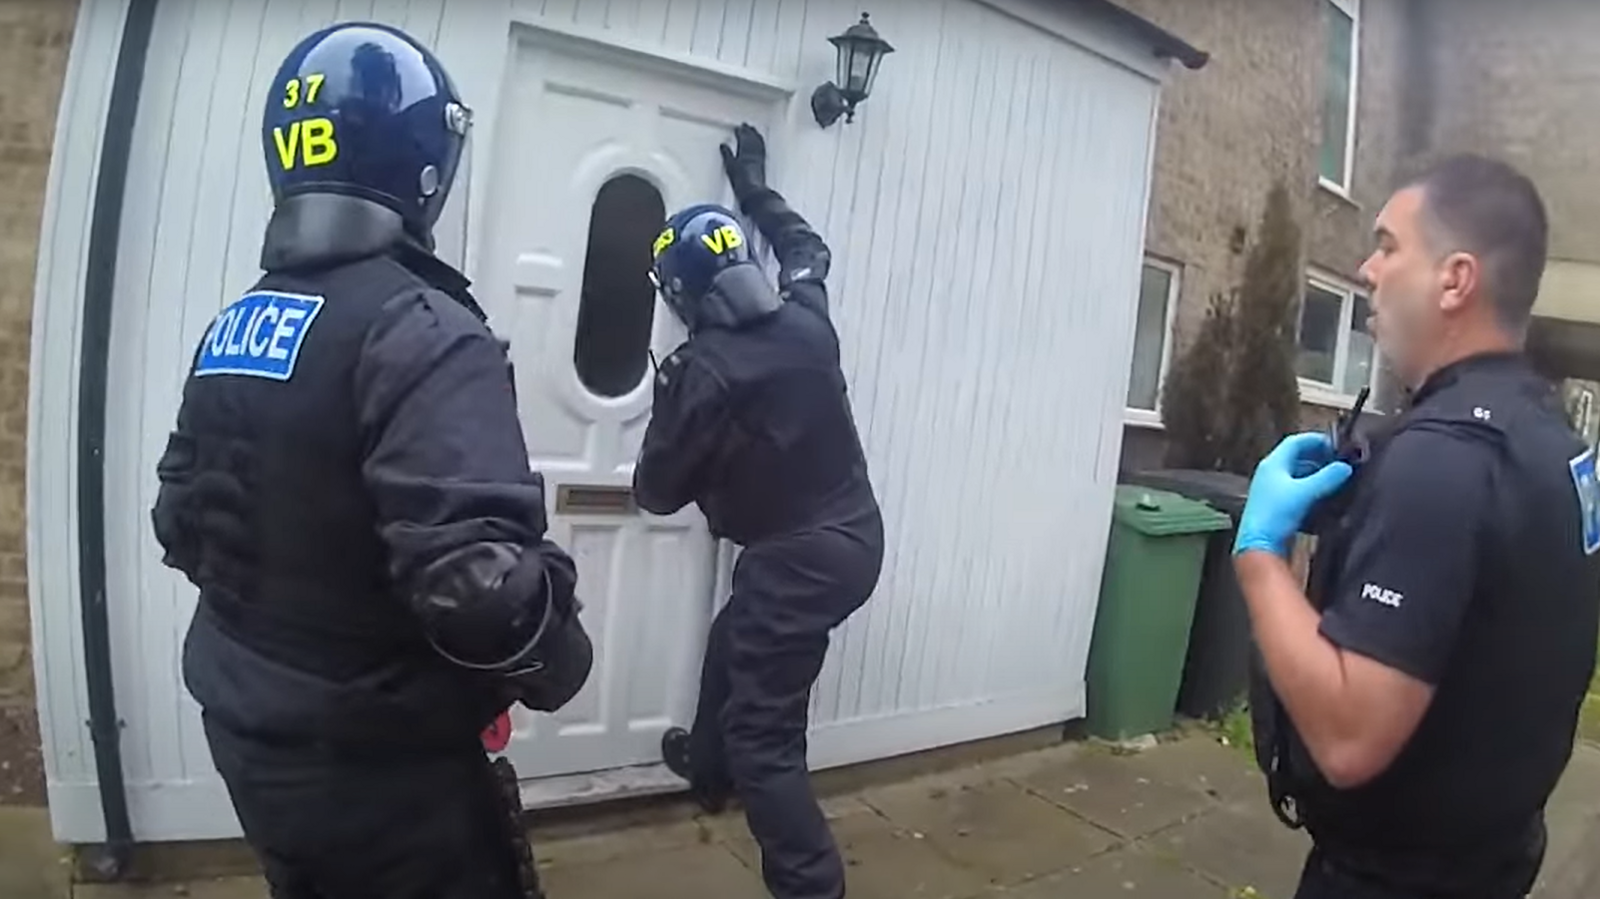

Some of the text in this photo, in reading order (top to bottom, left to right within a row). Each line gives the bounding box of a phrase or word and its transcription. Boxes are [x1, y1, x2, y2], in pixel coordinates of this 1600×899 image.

[283, 74, 324, 108] 37
[273, 118, 337, 170] VB
[701, 225, 743, 255] VB
[1361, 583, 1404, 607] POLICE
